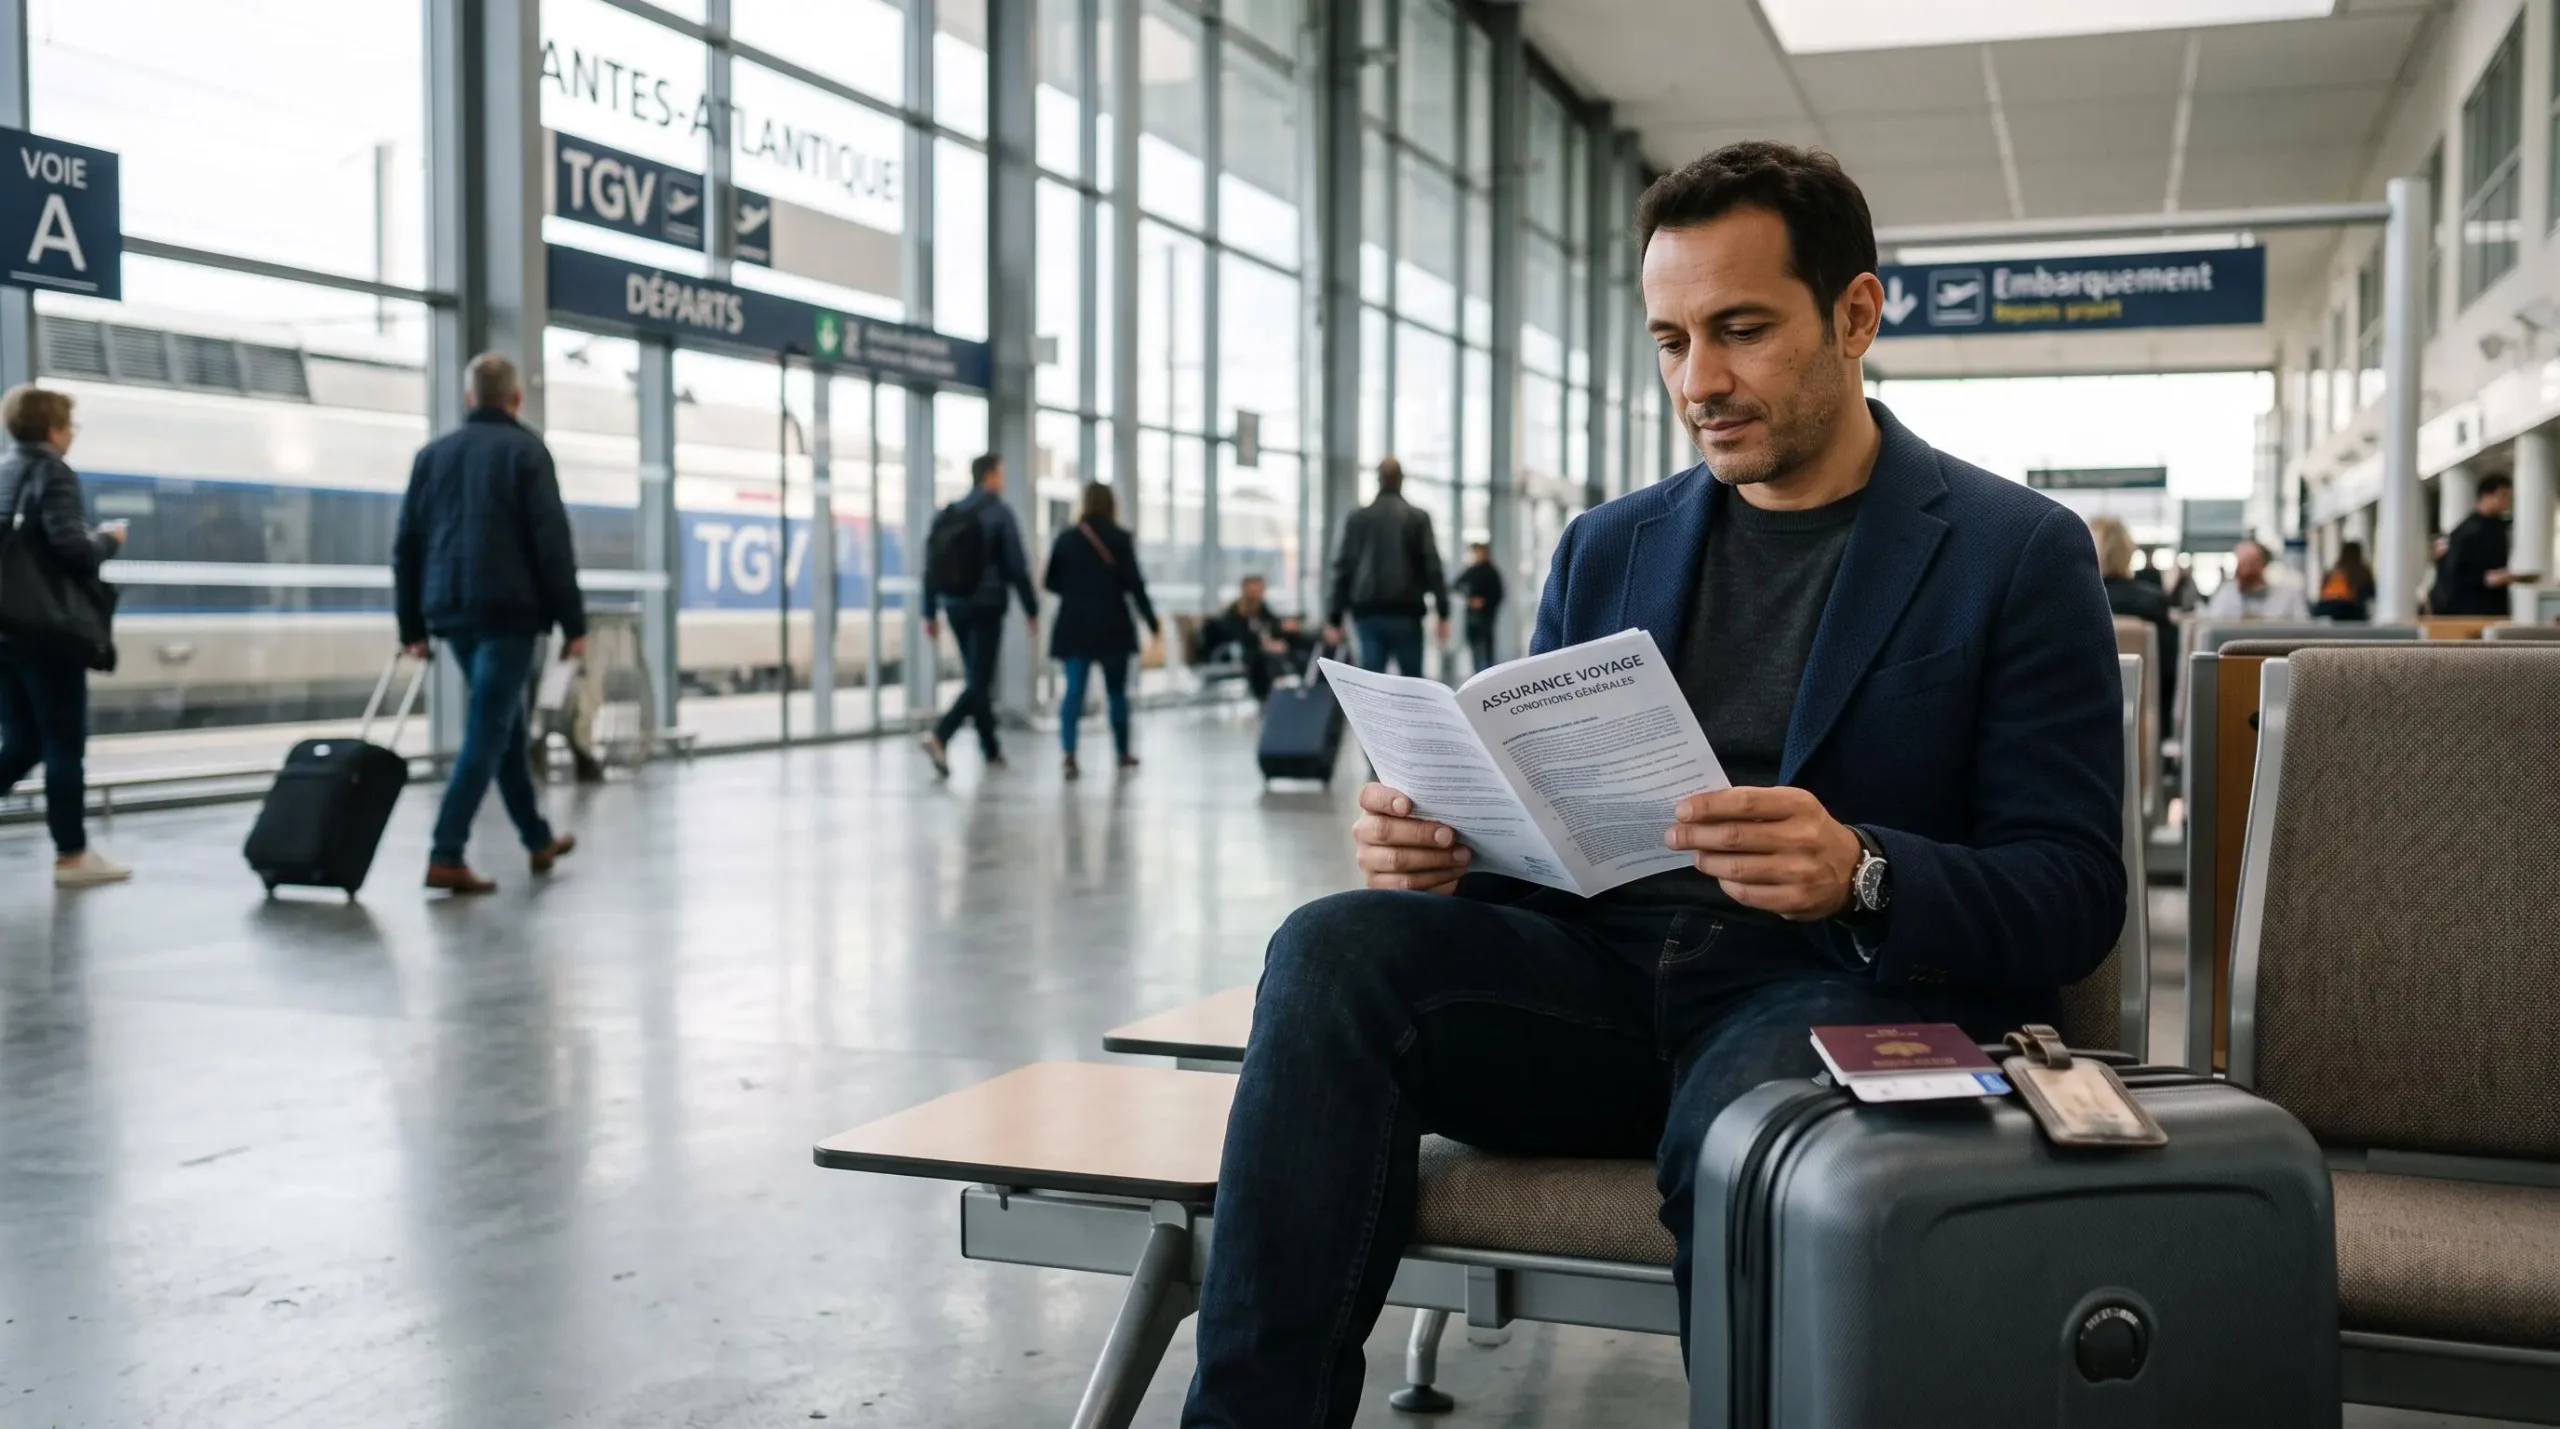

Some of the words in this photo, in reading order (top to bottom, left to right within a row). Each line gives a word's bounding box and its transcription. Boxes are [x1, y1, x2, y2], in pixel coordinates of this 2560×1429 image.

[20, 147, 87, 190] VOIE
[561, 147, 656, 226] TGV
[27, 193, 87, 271] A
[626, 270, 744, 335] DÉPARTS
[1993, 261, 2213, 302] Embarquement
[1482, 672, 1575, 712] ASSURANCE
[1576, 654, 1644, 682] VOYAGE
